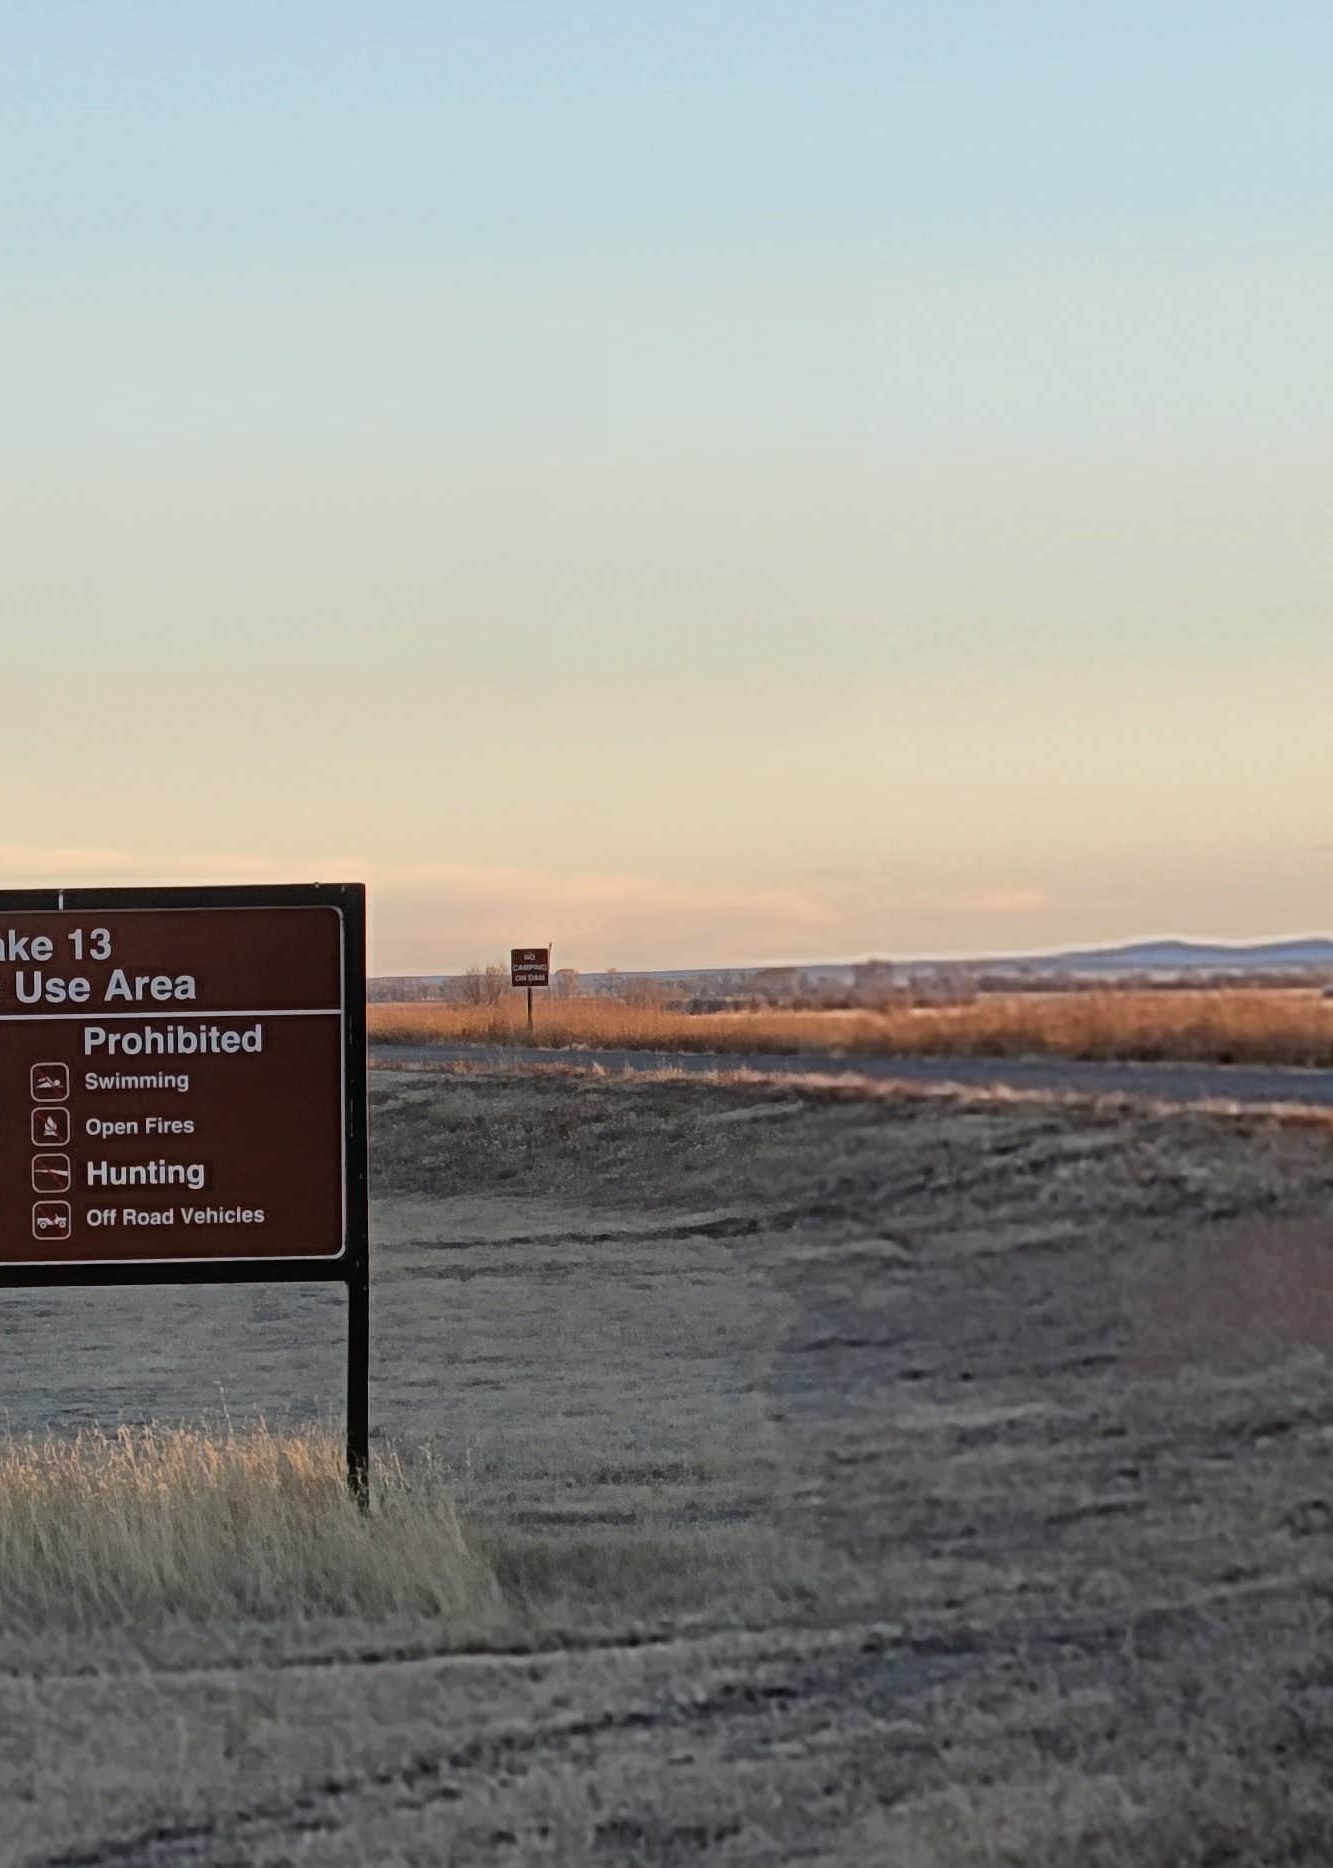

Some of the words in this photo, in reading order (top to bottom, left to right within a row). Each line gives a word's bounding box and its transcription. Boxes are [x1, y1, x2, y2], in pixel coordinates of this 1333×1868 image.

[68, 928, 111, 960] 13
[16, 971, 90, 1003] Use
[104, 969, 196, 1001] Area
[85, 1025, 261, 1055] Prohibited
[85, 1072, 188, 1092] Swimming
[86, 1118, 138, 1139] Open
[146, 1117, 194, 1133] Fires
[88, 1160, 204, 1189] Hunting
[87, 1209, 116, 1226] Off
[123, 1208, 172, 1225] Road
[182, 1207, 264, 1224] Vehicles
